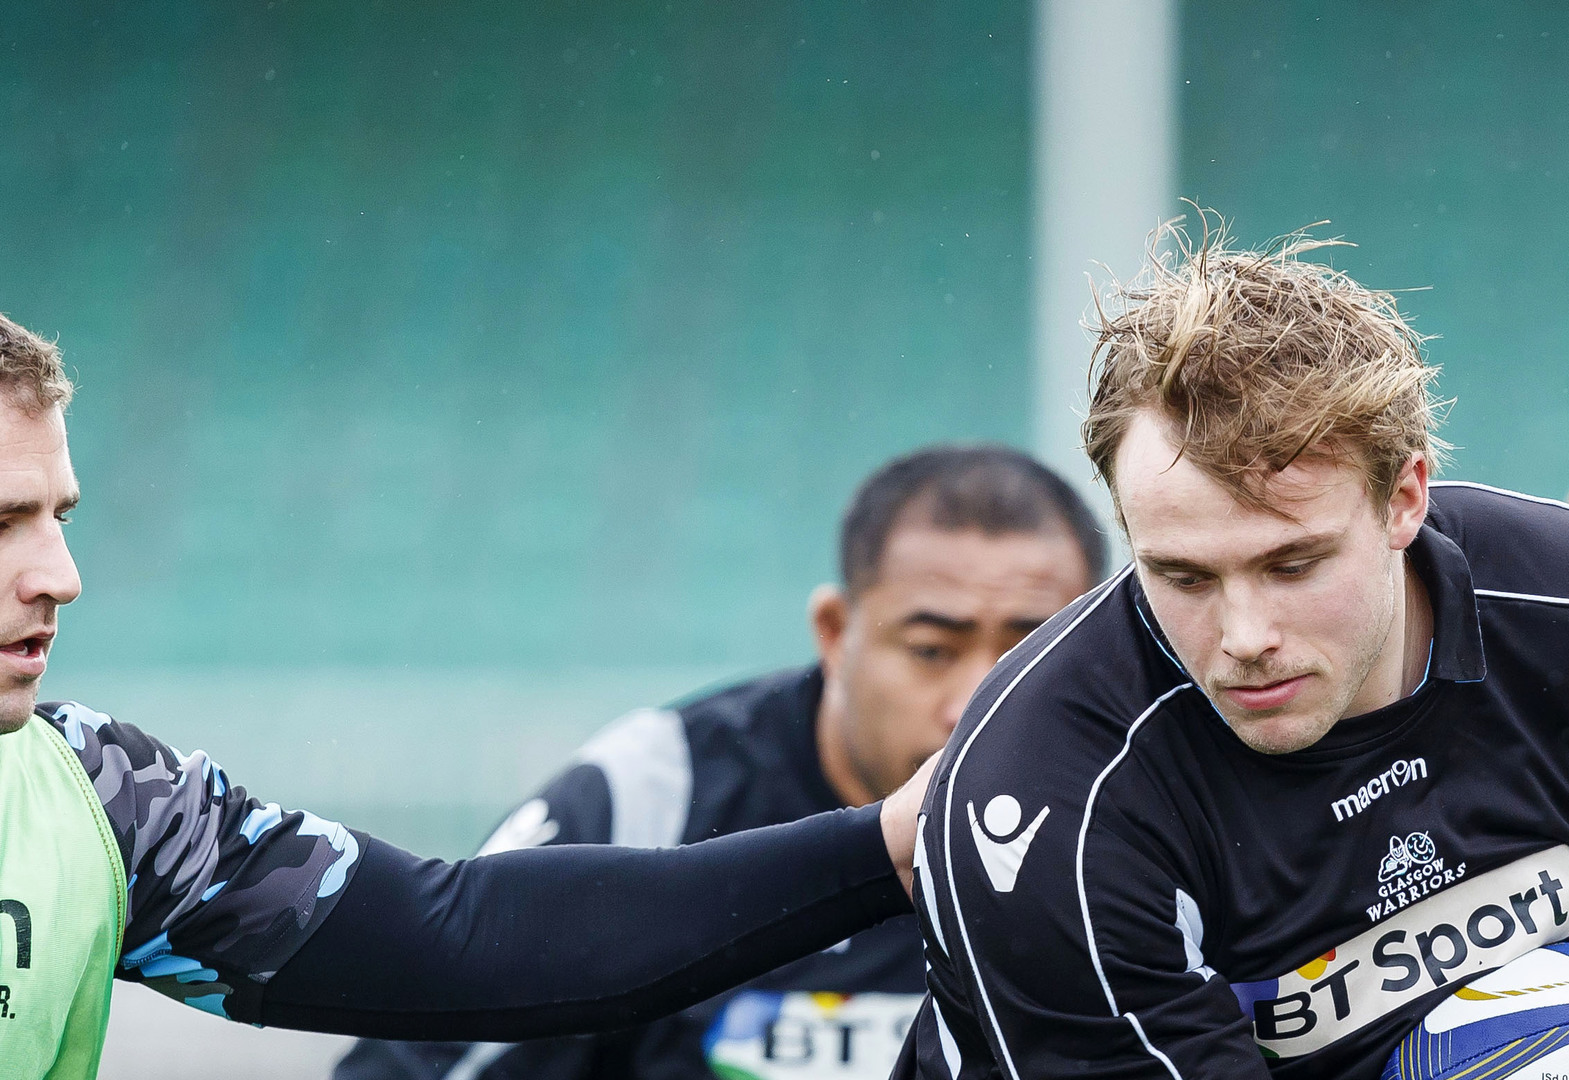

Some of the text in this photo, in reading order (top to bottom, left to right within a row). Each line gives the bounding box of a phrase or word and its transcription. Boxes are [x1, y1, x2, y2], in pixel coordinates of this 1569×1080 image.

[1331, 757, 1428, 822] macron
[1366, 862, 1467, 922] WARRIORS
[1378, 858, 1445, 898] GLASGOW
[1254, 869, 1569, 1041] BT Sport
